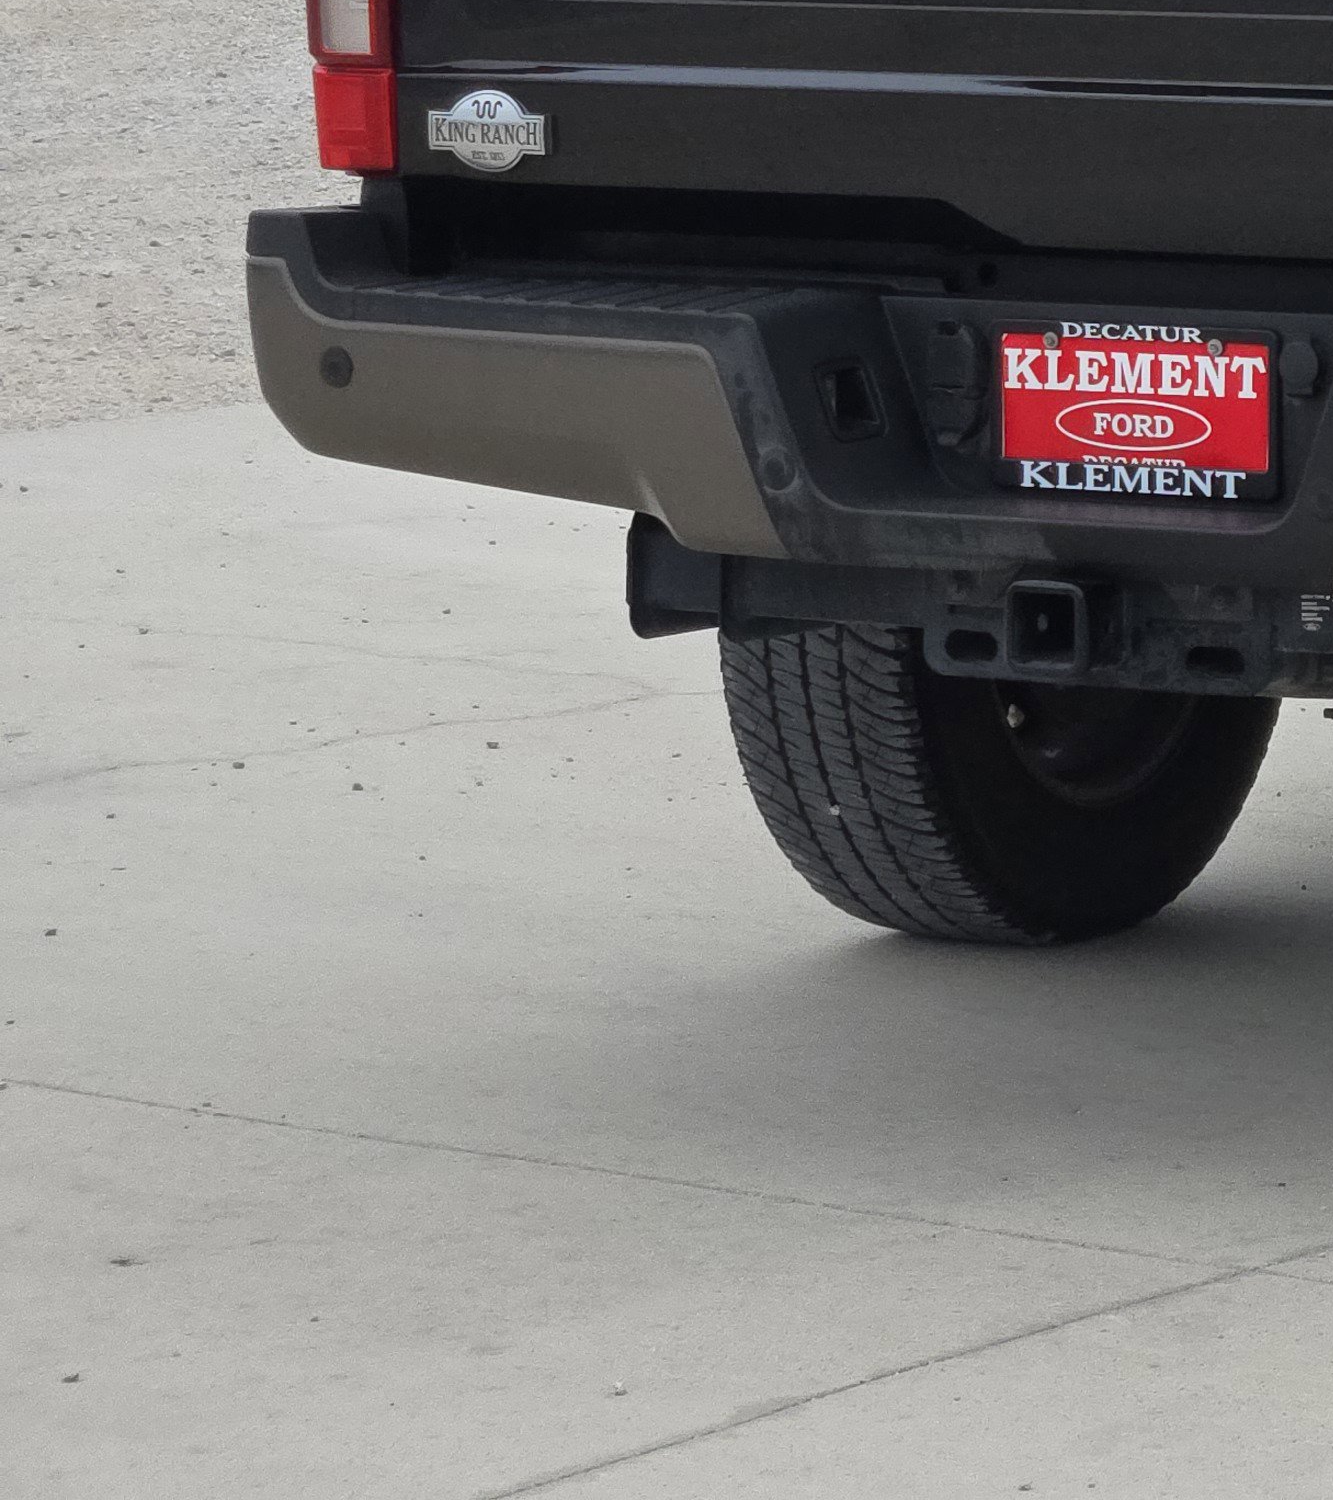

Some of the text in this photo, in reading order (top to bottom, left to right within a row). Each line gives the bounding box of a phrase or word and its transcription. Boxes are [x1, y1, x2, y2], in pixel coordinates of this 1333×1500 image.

[434, 117, 538, 146] KING RANCH
[1060, 321, 1204, 344] DECATUR
[1003, 347, 1266, 399] KLEMENT
[1093, 412, 1175, 438] FORD
[1020, 460, 1246, 499] KLEMENT
